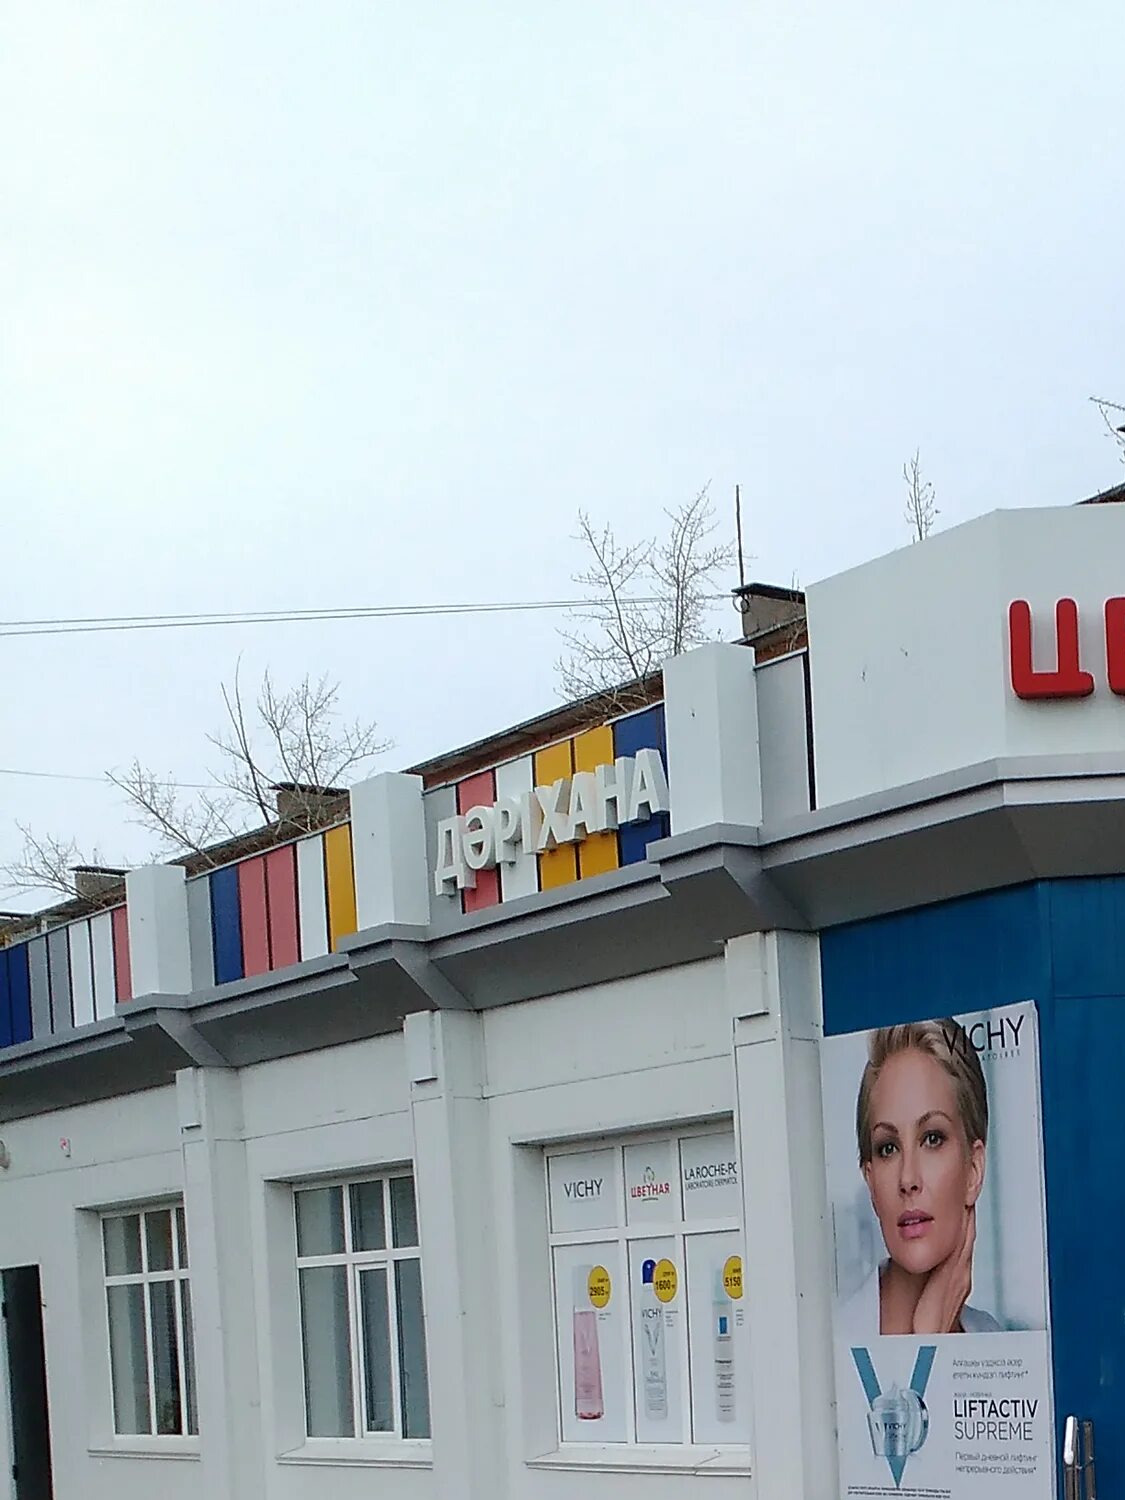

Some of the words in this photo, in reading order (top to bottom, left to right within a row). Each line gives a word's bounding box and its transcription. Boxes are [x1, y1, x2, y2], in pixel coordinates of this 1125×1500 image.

[435, 748, 670, 896] ДӘРІХАНА
[942, 1015, 1024, 1056] VICHY
[564, 1178, 603, 1198] VICHY
[631, 1182, 670, 1199] ЦВЕТНАЯ
[954, 1399, 1039, 1418] LIFTACTIV
[954, 1421, 1033, 1440] SUPREME
